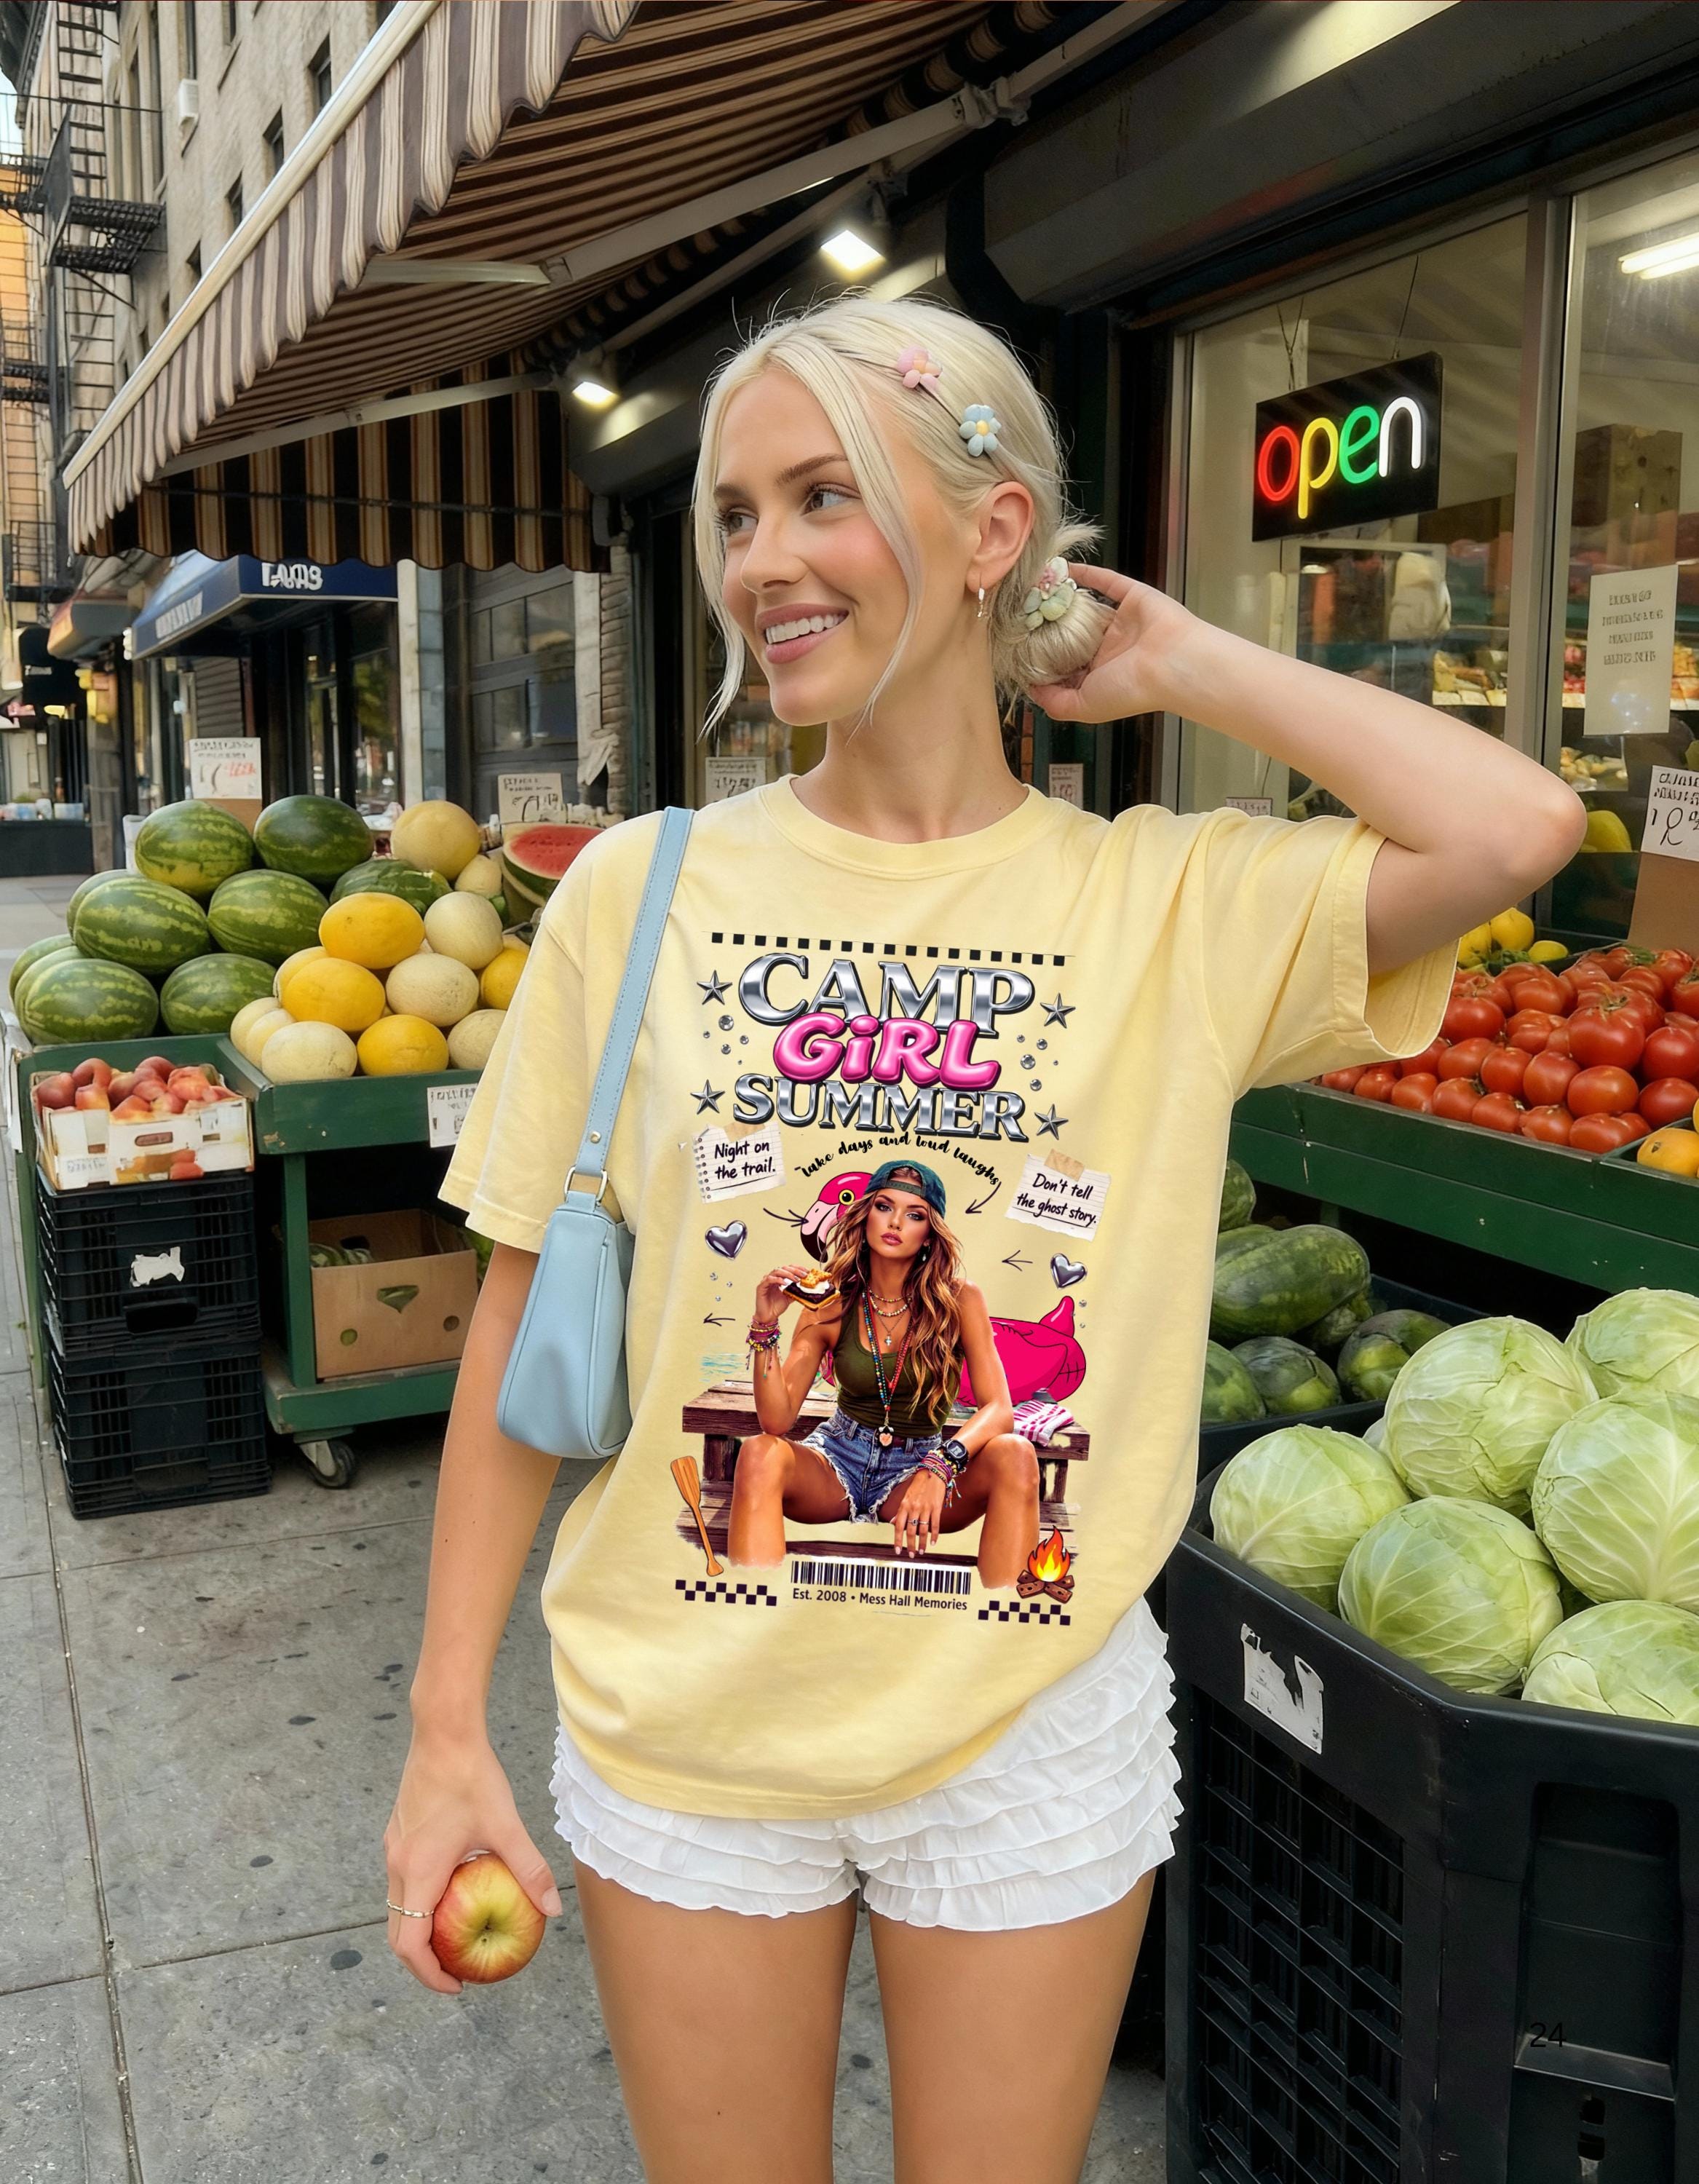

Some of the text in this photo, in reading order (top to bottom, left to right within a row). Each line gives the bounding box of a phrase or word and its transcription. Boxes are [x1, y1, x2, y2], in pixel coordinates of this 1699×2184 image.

[1258, 396, 1422, 519] open
[738, 951, 1035, 1039] CAMP
[733, 1072, 1029, 1142] SUMMER
[714, 1140, 770, 1164] Night on
[714, 1156, 777, 1180] the trail.
[838, 1139, 874, 1155] days
[879, 1131, 911, 1146] and
[916, 1135, 951, 1154] loud
[953, 1147, 999, 1185] laughs
[1032, 1173, 1094, 1200] Don't tell
[1016, 1192, 1097, 1227] the ghost story.
[792, 1588, 967, 1610] Est. 2008 Mess Hall Memories
